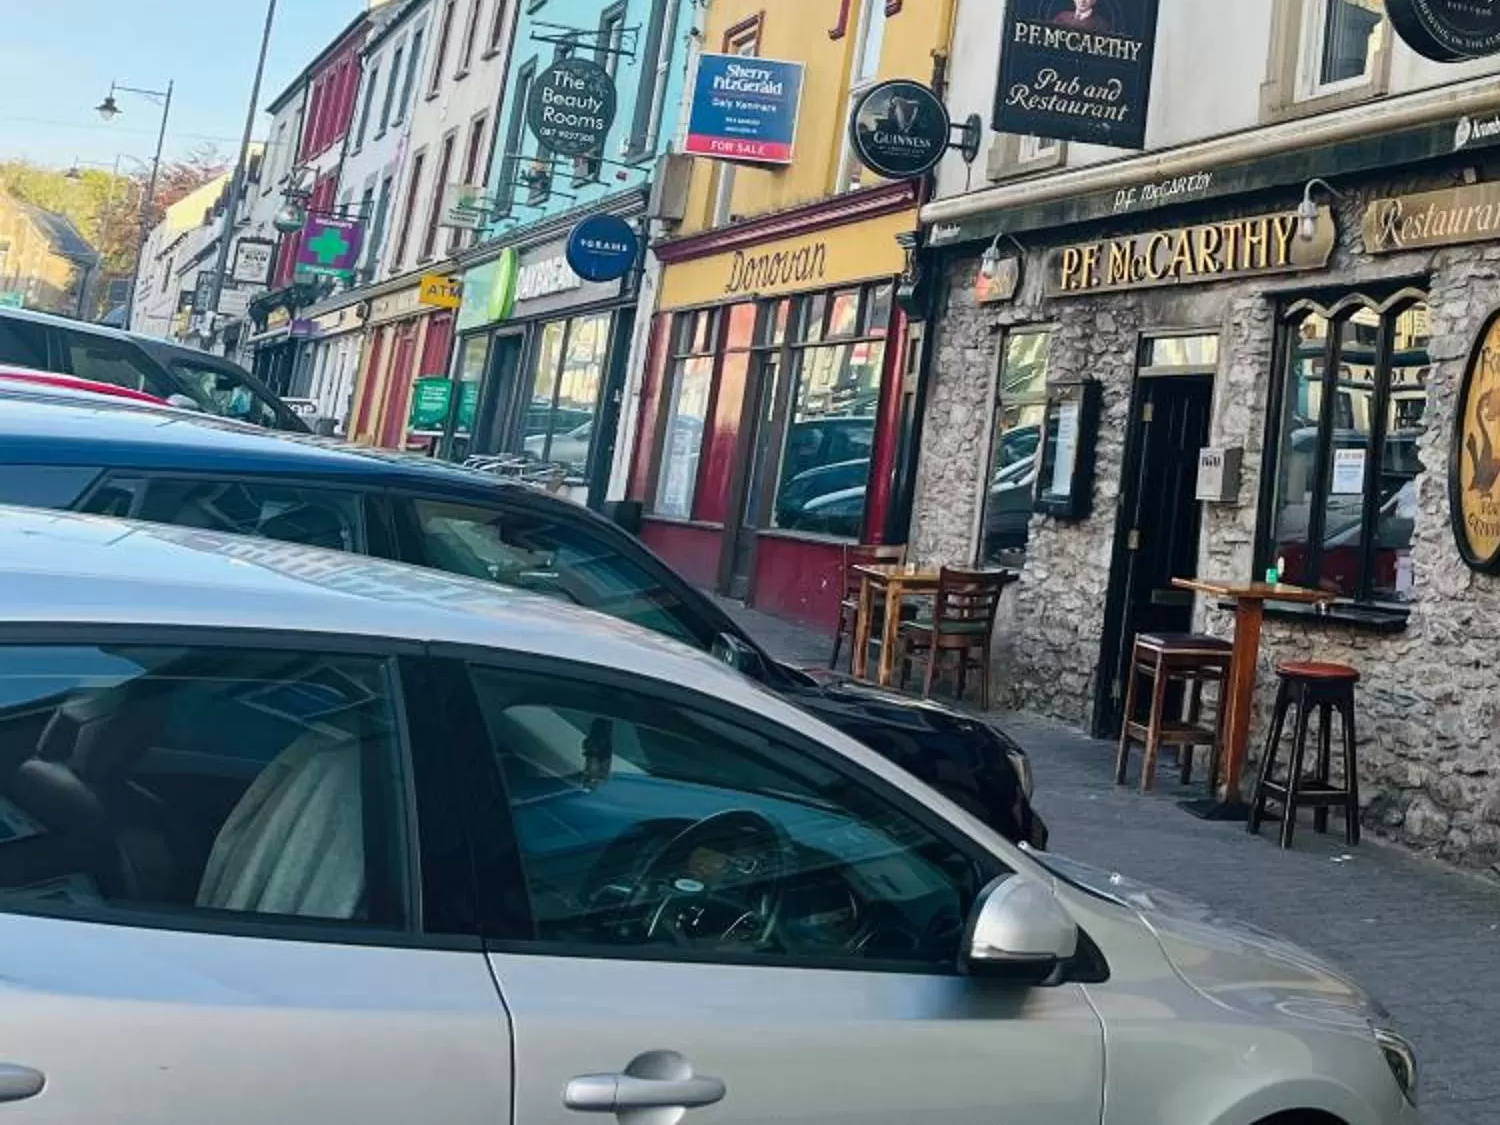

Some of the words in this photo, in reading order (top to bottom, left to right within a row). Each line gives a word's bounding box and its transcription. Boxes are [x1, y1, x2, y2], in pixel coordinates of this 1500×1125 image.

[553, 70, 585, 89] The
[726, 64, 773, 80] Sherry
[1034, 68, 1080, 96] Pub
[1083, 79, 1122, 101] and
[542, 87, 603, 113] Beauty
[1006, 84, 1128, 121] Restaurant
[544, 106, 603, 129] Rooms
[710, 141, 734, 151] FOR
[737, 143, 765, 155] SALE
[874, 132, 931, 147] GUINNESS
[1061, 248, 1098, 290] P.F.
[1107, 215, 1299, 284] McCARTHY
[725, 242, 825, 293] Donovan
[428, 283, 462, 299] ATM
